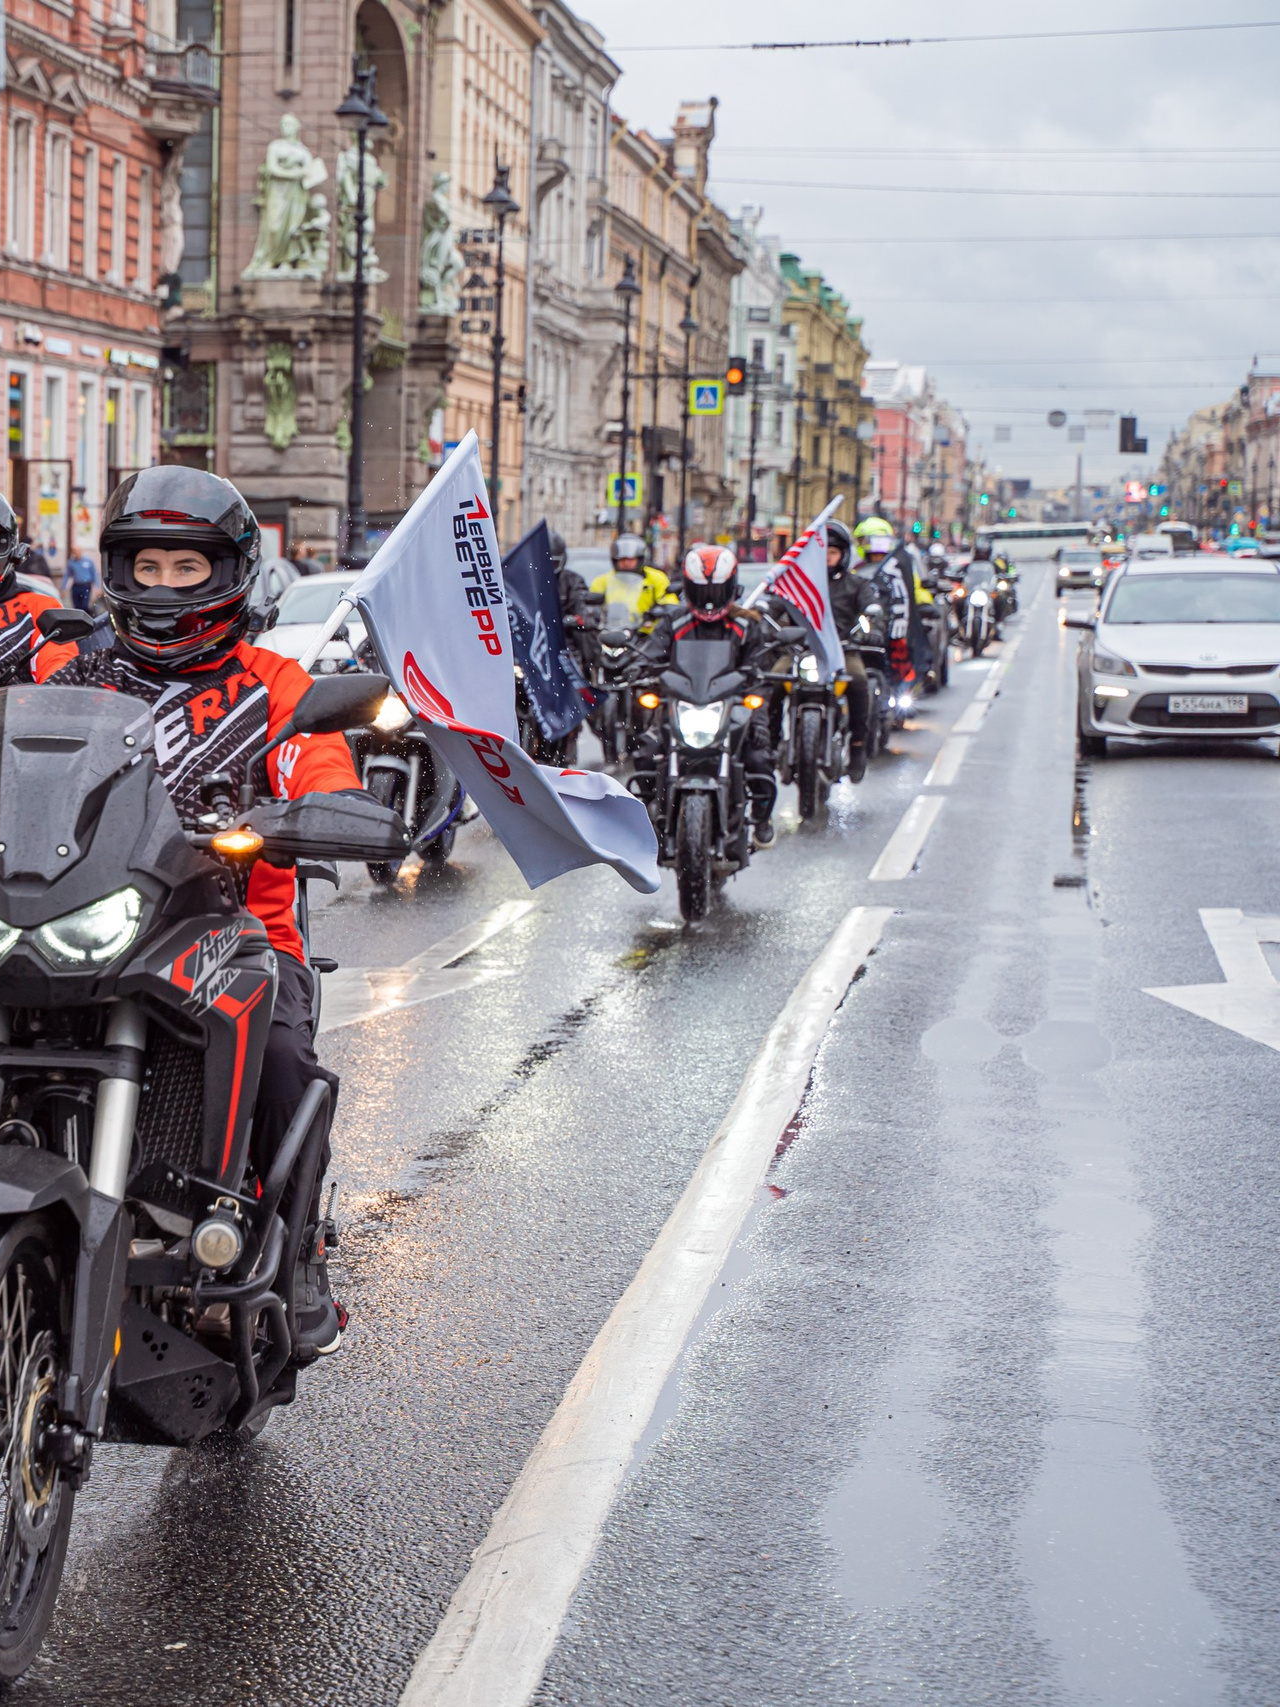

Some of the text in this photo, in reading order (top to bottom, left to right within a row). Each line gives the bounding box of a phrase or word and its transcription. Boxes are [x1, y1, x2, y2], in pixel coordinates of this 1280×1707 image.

[453, 514, 503, 656] ВЕТЕРР
[459, 493, 503, 604] ПЕРВЫЙ
[192, 918, 245, 988] Africa
